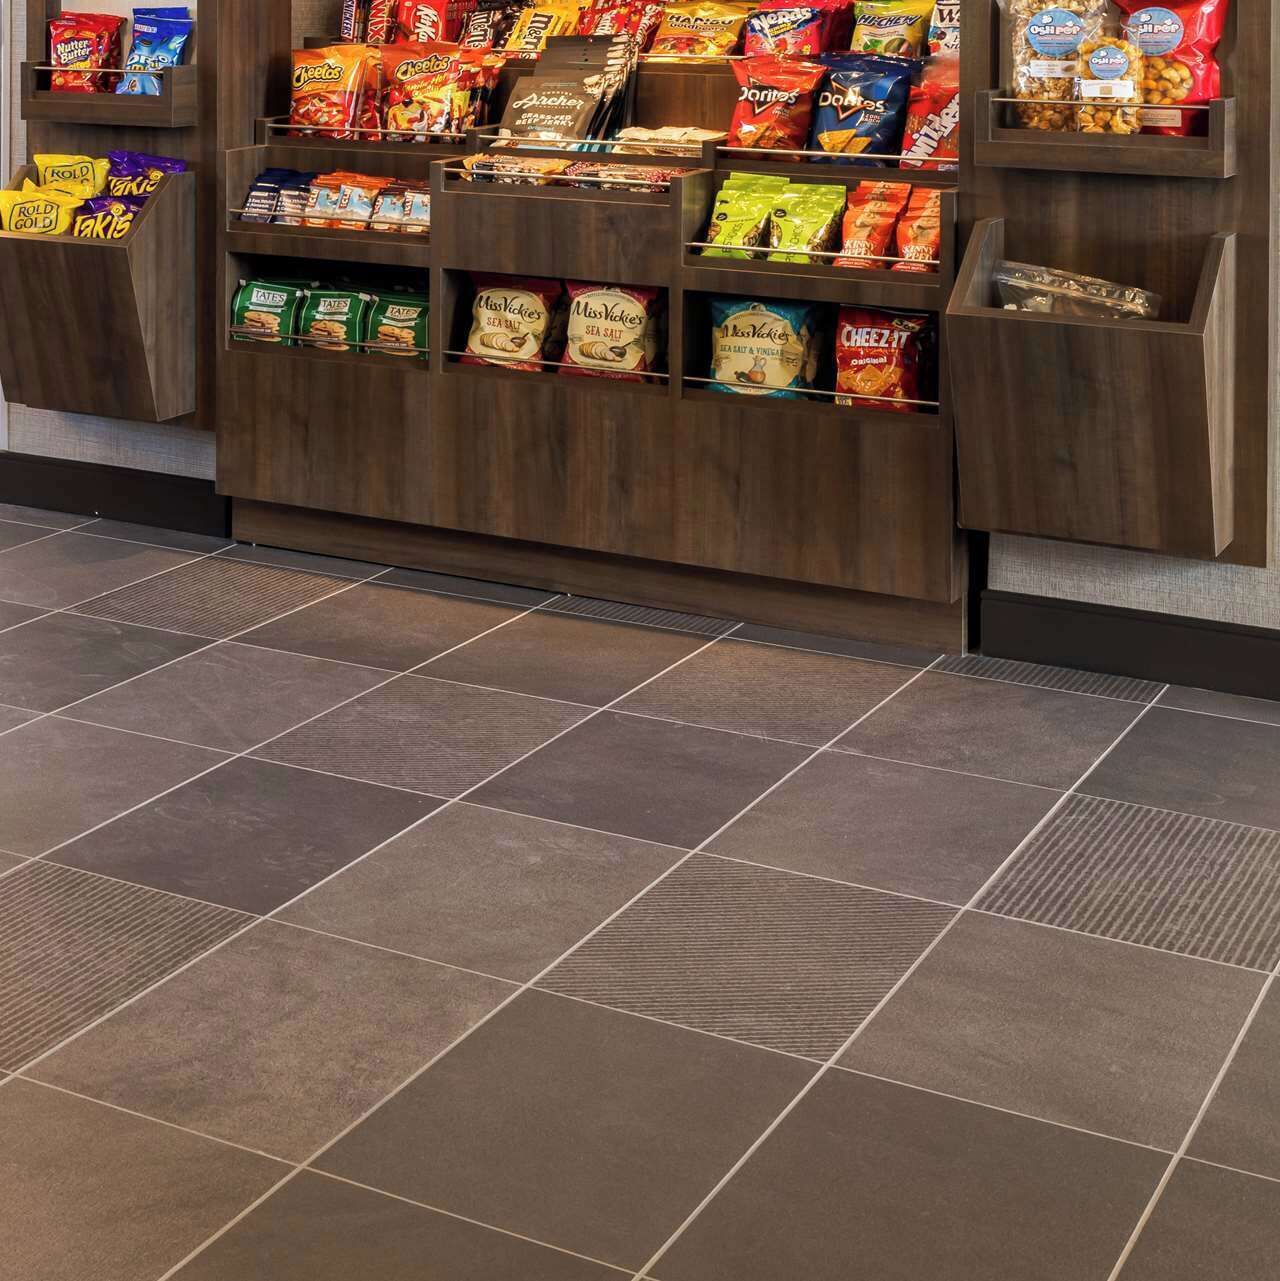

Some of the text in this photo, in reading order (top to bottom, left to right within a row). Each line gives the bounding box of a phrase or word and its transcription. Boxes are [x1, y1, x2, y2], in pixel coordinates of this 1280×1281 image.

[668, 13, 736, 25] HARIBO
[857, 13, 921, 29] HI-CHEW
[56, 39, 89, 54] Nutter
[60, 46, 93, 64] Butter
[293, 63, 344, 89] Cheetos
[396, 55, 450, 82] Cheetos
[512, 93, 585, 110] Archer
[738, 86, 800, 106] Doritos
[515, 118, 575, 127] BEEF JERKY
[521, 112, 572, 120] GRASS-FED
[51, 163, 90, 180] ROLD
[18, 204, 54, 217] ROLD
[14, 215, 53, 230] GOLD
[254, 289, 285, 302] TATE'S
[322, 299, 349, 310] TATE'S
[390, 306, 418, 317] TATE'S
[502, 295, 544, 323] Vickie's
[571, 300, 645, 329] Miss Vickie's
[486, 317, 522, 331] SEA SALT
[585, 325, 623, 339] SEA SALT
[750, 322, 791, 345] Vickie's
[840, 325, 912, 349] CHEEZ-IT
[720, 343, 733, 353] SEA
[733, 345, 747, 354] SALT
[748, 346, 755, 354] &
